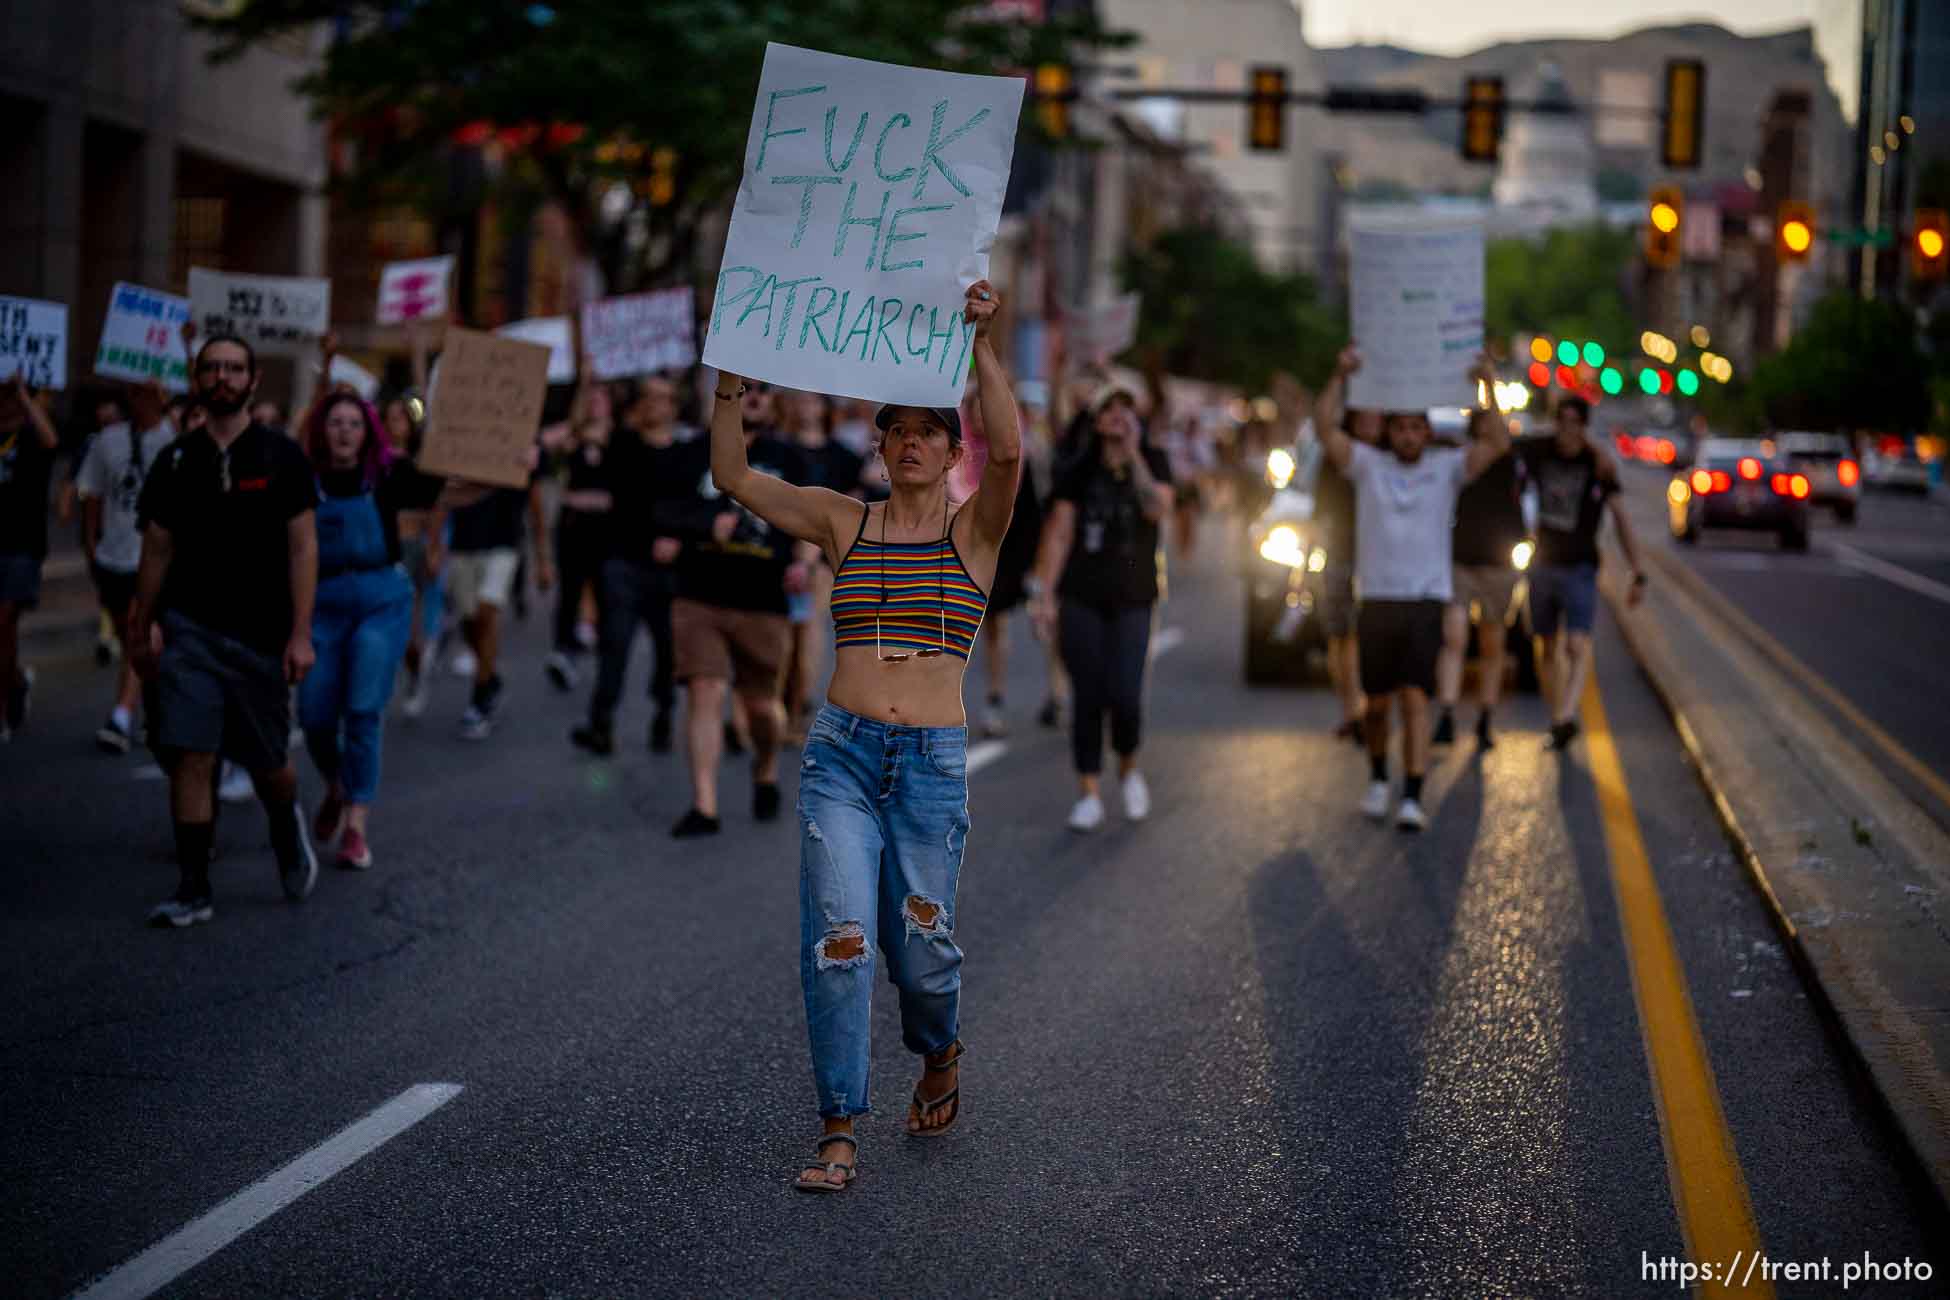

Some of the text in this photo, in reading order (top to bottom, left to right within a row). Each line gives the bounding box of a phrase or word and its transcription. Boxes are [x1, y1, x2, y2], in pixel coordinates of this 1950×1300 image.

[755, 85, 991, 200] FUCK
[771, 175, 954, 272] THE
[712, 265, 977, 388] PATRIARCHY
